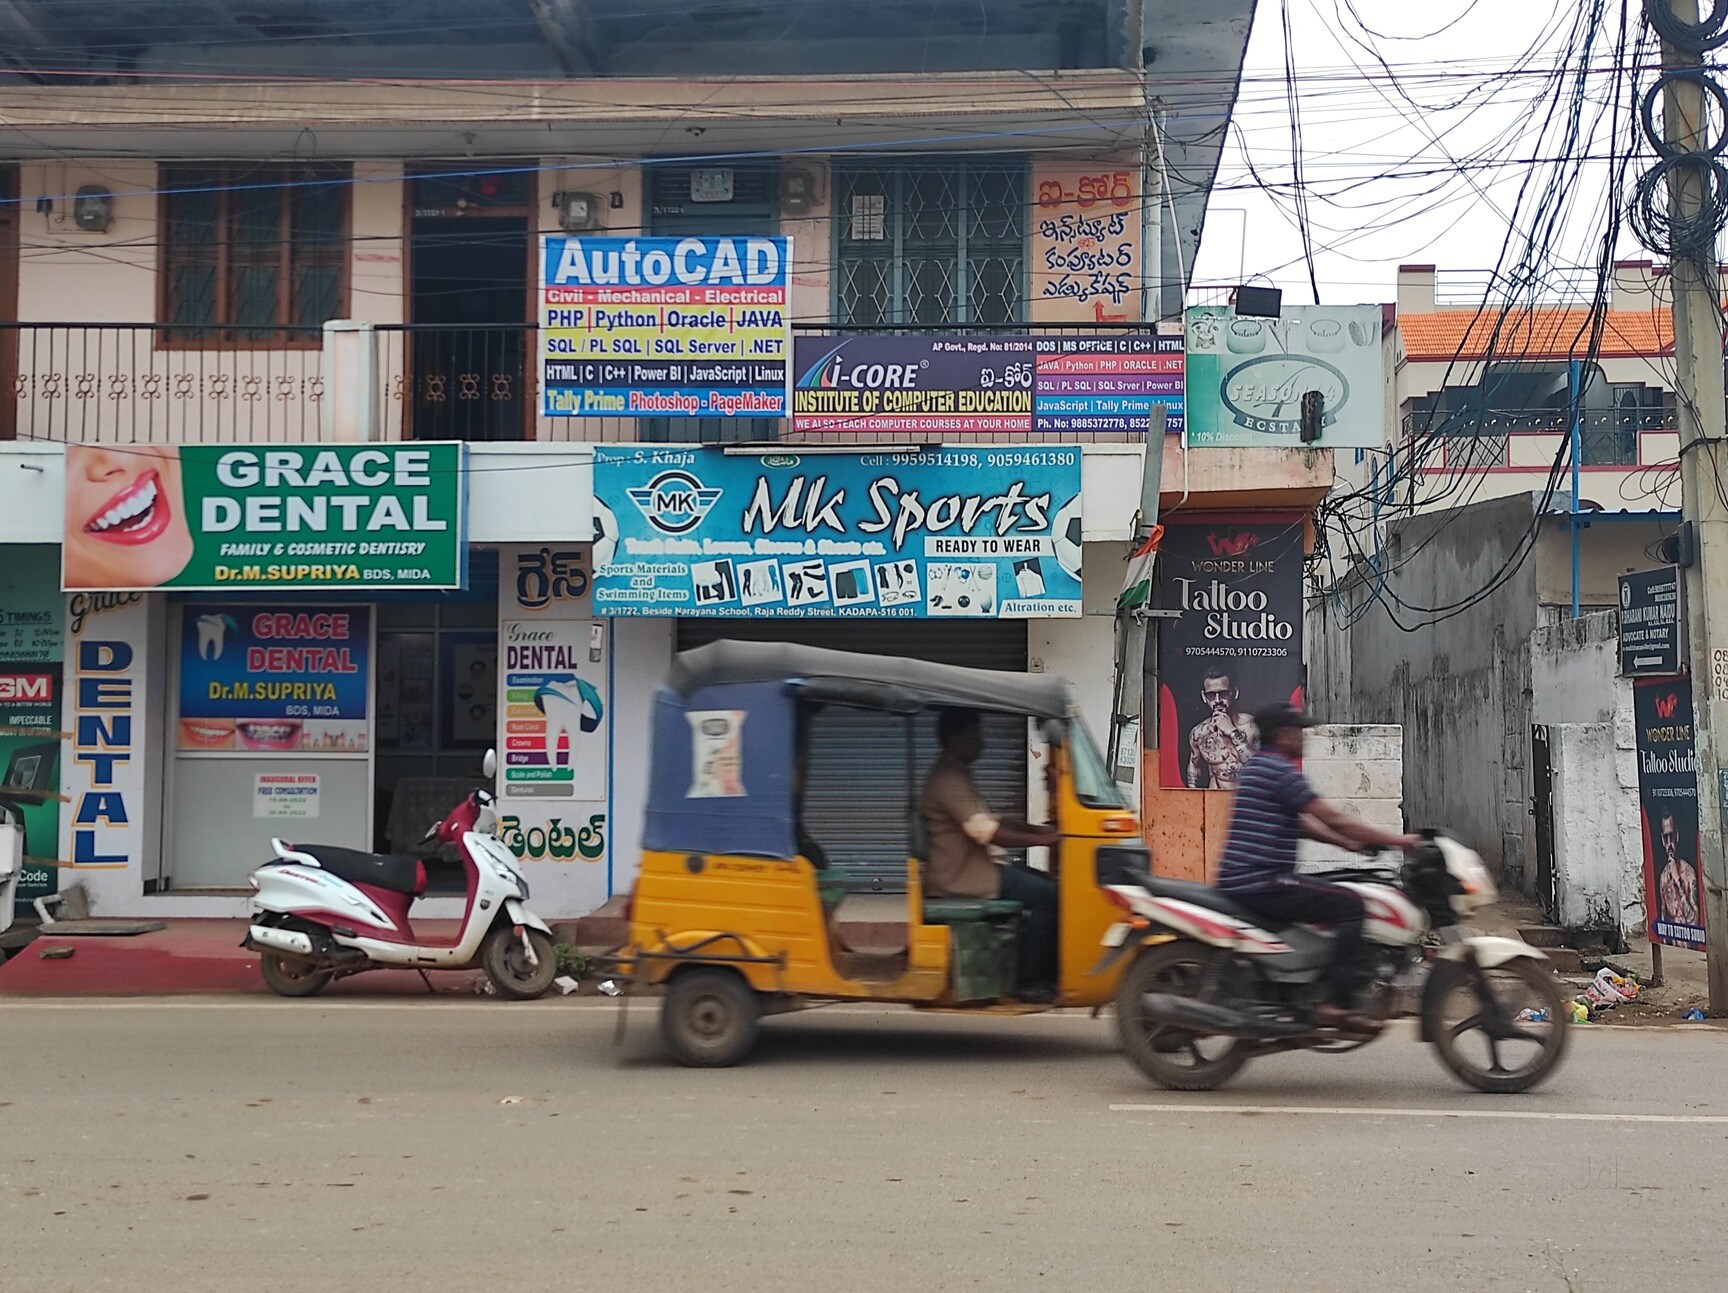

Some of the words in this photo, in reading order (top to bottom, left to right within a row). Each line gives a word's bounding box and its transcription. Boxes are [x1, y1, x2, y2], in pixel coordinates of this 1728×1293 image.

[554, 238, 779, 285] AutoCAD
[598, 290, 690, 303] Mechanical
[705, 290, 782, 303] Electrical
[548, 309, 583, 326] PHP
[595, 310, 656, 331] Python
[667, 310, 726, 328] Oracle
[736, 310, 783, 328] JAVA
[548, 339, 576, 354] SQL
[590, 339, 607, 353] PL
[612, 339, 641, 353] SQL
[655, 339, 684, 353] SQL
[688, 339, 736, 353] Server
[749, 339, 783, 353] .NET
[933, 342, 943, 351] AP
[968, 342, 989, 353] Regd.
[1004, 342, 1033, 351] 81/2014
[1036, 341, 1056, 352] DOS
[1063, 341, 1077, 351] MS
[1079, 341, 1113, 351] OFFICE
[1119, 341, 1127, 351] C
[1133, 341, 1151, 351] C++
[1158, 341, 1184, 351] HTML
[546, 365, 577, 381] HTML
[585, 365, 594, 380] C
[605, 365, 626, 380] C++
[634, 366, 669, 381] Power
[670, 366, 681, 381] BI
[689, 366, 747, 384] JavaScript
[755, 366, 784, 381] Linux
[1038, 361, 1059, 370] JAVA
[1066, 361, 1094, 372] Python
[1100, 361, 1117, 369] PHP
[1124, 361, 1157, 369] ORACLE
[1163, 361, 1183, 369] .NET
[1037, 381, 1055, 391] SQL
[1062, 381, 1072, 390] PL
[1074, 381, 1091, 390] SQL
[1098, 381, 1115, 390] SQL
[1117, 381, 1140, 390] Srver
[1147, 381, 1173, 390] Power
[1174, 381, 1184, 389] BI
[547, 390, 581, 415] Tally
[584, 391, 625, 409] Prime
[629, 391, 699, 414] Photoshop
[709, 391, 783, 415] PageMaker
[794, 391, 860, 412] INSTITUTE
[863, 391, 879, 411] OF
[883, 391, 955, 412] COMPUTER
[958, 391, 1032, 412] EDUCATION
[1037, 400, 1088, 411] JavaScript
[1096, 400, 1119, 412] Tally
[1121, 400, 1150, 410] Prime
[796, 420, 810, 429] WE
[811, 420, 835, 429] ALSO
[837, 420, 866, 429] TEACH
[869, 420, 917, 429] COMPUTER
[920, 419, 961, 428] COURSES
[963, 419, 975, 428] AT
[977, 419, 1001, 428] YOUR
[1004, 419, 1030, 428] HOME
[1038, 419, 1051, 428] Ph.
[1054, 419, 1069, 428] No:
[1197, 432, 1214, 441] 10%
[633, 451, 647, 464] S.
[652, 451, 695, 468] Khaja
[892, 453, 983, 469] 9959514198,
[987, 452, 1075, 467] 9059461380
[216, 451, 431, 487] GRACE
[657, 492, 695, 512] MK
[202, 496, 447, 532] DENTAL
[858, 477, 1051, 551] Sports
[220, 543, 271, 556] FAMILY
[288, 543, 355, 555] COSMETIC
[936, 540, 977, 552] READY
[982, 540, 998, 552] TO
[1003, 539, 1041, 552] WEAR
[215, 565, 360, 580] Dr.M.SUPRIYA
[363, 569, 395, 580] BDS,
[397, 569, 431, 579] MIDA
[599, 564, 634, 576] Sports
[636, 563, 687, 574] Materials
[1192, 560, 1245, 573] WONDER
[1250, 561, 1274, 573] LINE
[632, 577, 653, 586] and
[598, 590, 655, 601] Swimming
[658, 590, 688, 599] Items
[1173, 577, 1267, 611] Tattoo
[642, 607, 672, 615] Beside
[675, 607, 716, 616] Narayana
[755, 608, 775, 617] Raja
[777, 608, 804, 617] Reddy
[839, 609, 897, 617] KADAPA-516
[1005, 602, 1055, 612] Altration
[1057, 603, 1077, 612] etc.
[253, 613, 349, 639] GRACE
[508, 623, 557, 641] Grace
[1203, 613, 1294, 640] Studio
[247, 648, 358, 672] DENTAL
[507, 646, 577, 669] DENTAL
[209, 681, 337, 700] Dr.M.SUPRIYA
[313, 705, 340, 715] MIDA
[1646, 727, 1674, 742] WONDER
[1676, 725, 1690, 740] LINE
[75, 641, 132, 863] DENTAL
[512, 754, 529, 763] Bridge
[1640, 750, 1668, 773] Tattoo
